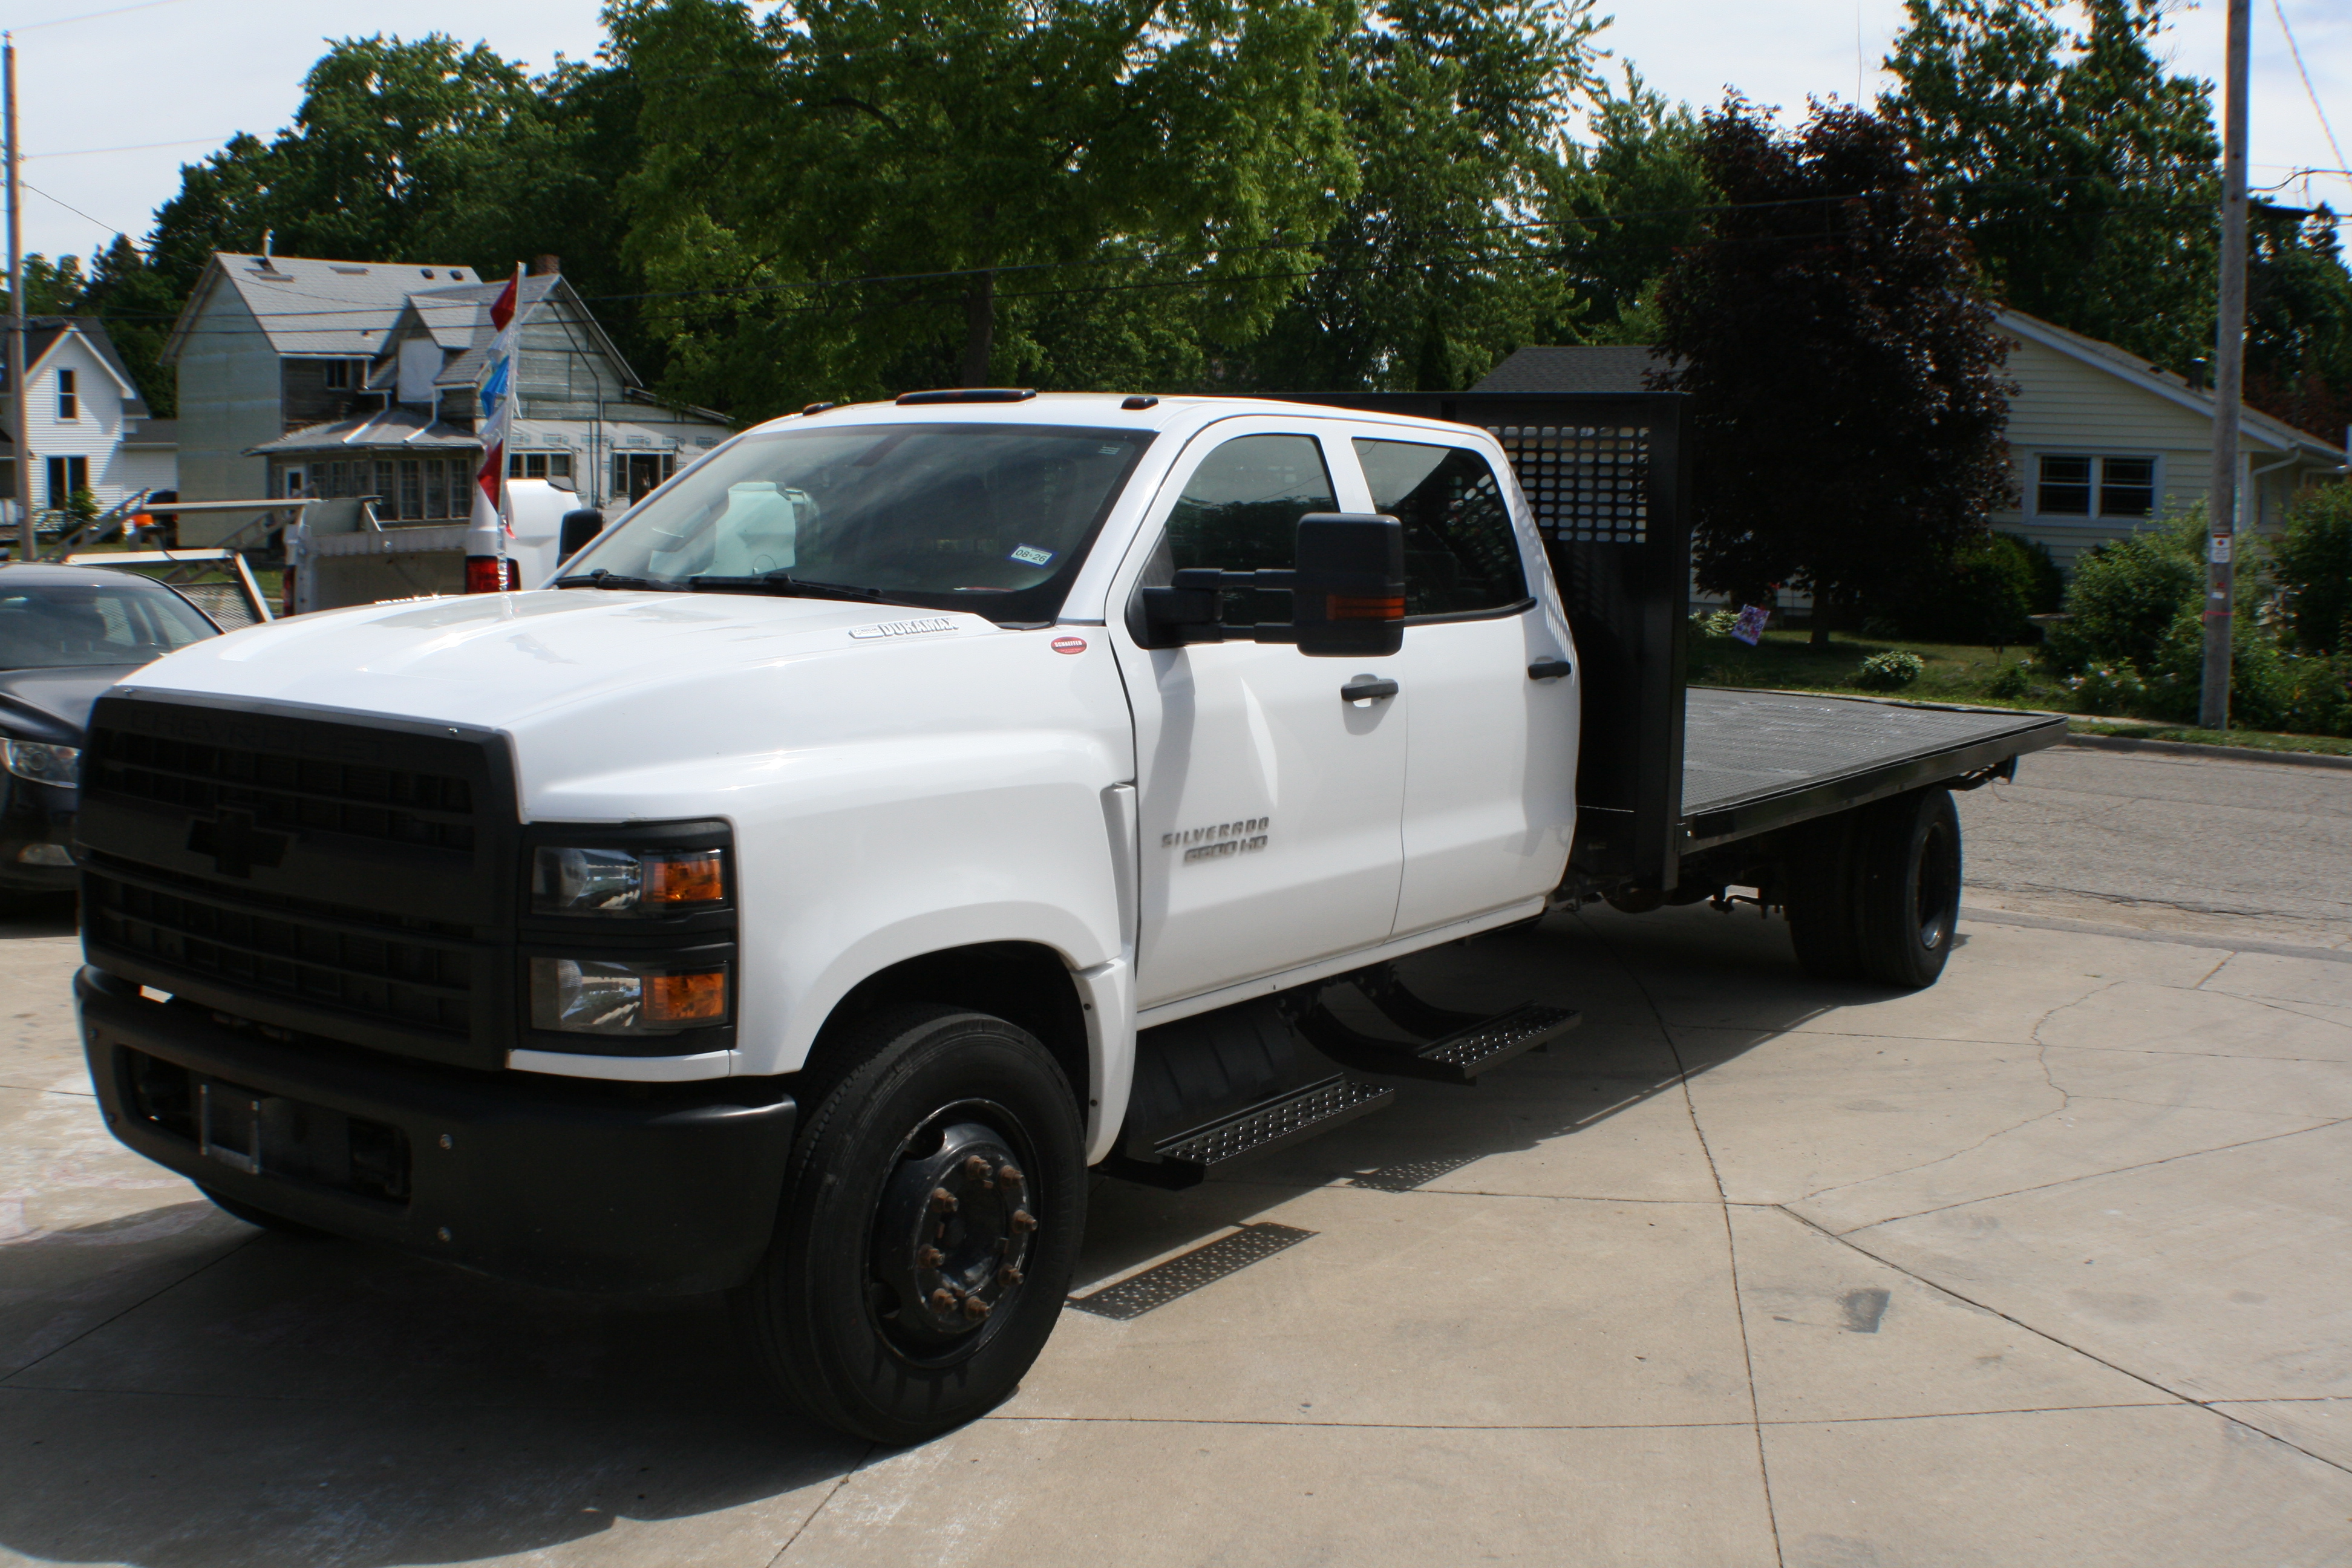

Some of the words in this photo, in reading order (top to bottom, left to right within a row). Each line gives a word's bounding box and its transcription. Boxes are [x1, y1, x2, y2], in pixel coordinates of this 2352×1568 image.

[1016, 549, 1030, 558] 08
[1032, 554, 1047, 563] 26
[878, 617, 959, 636] DURAMAX
[1161, 817, 1270, 848] SILVERADO
